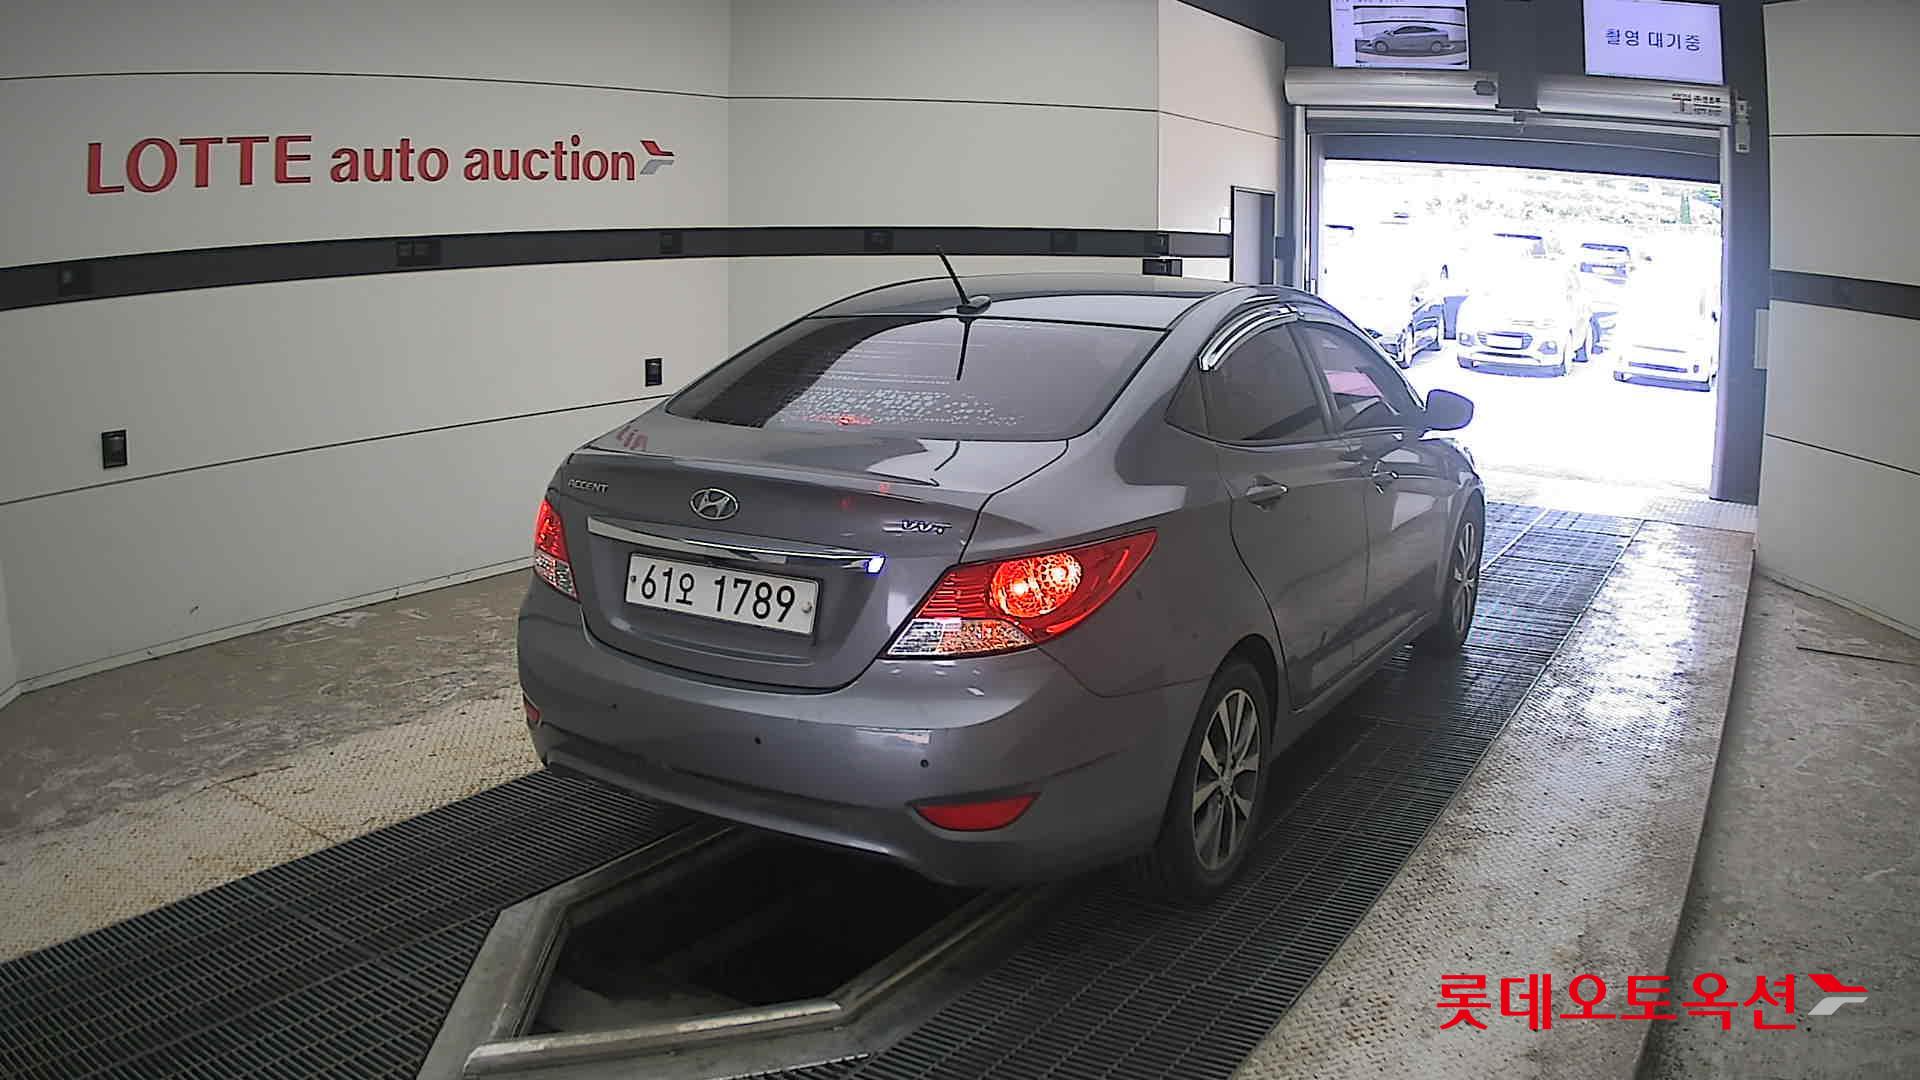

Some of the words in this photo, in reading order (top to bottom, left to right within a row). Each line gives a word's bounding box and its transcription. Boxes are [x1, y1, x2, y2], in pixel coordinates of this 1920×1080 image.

[1648, 31, 1701, 52] 대기중
[86, 135, 312, 194] LOTTE
[329, 137, 449, 183] auto
[463, 134, 636, 182] auction
[567, 479, 609, 493] ACCENT
[641, 564, 695, 606] 61오
[714, 575, 796, 623] 1789
